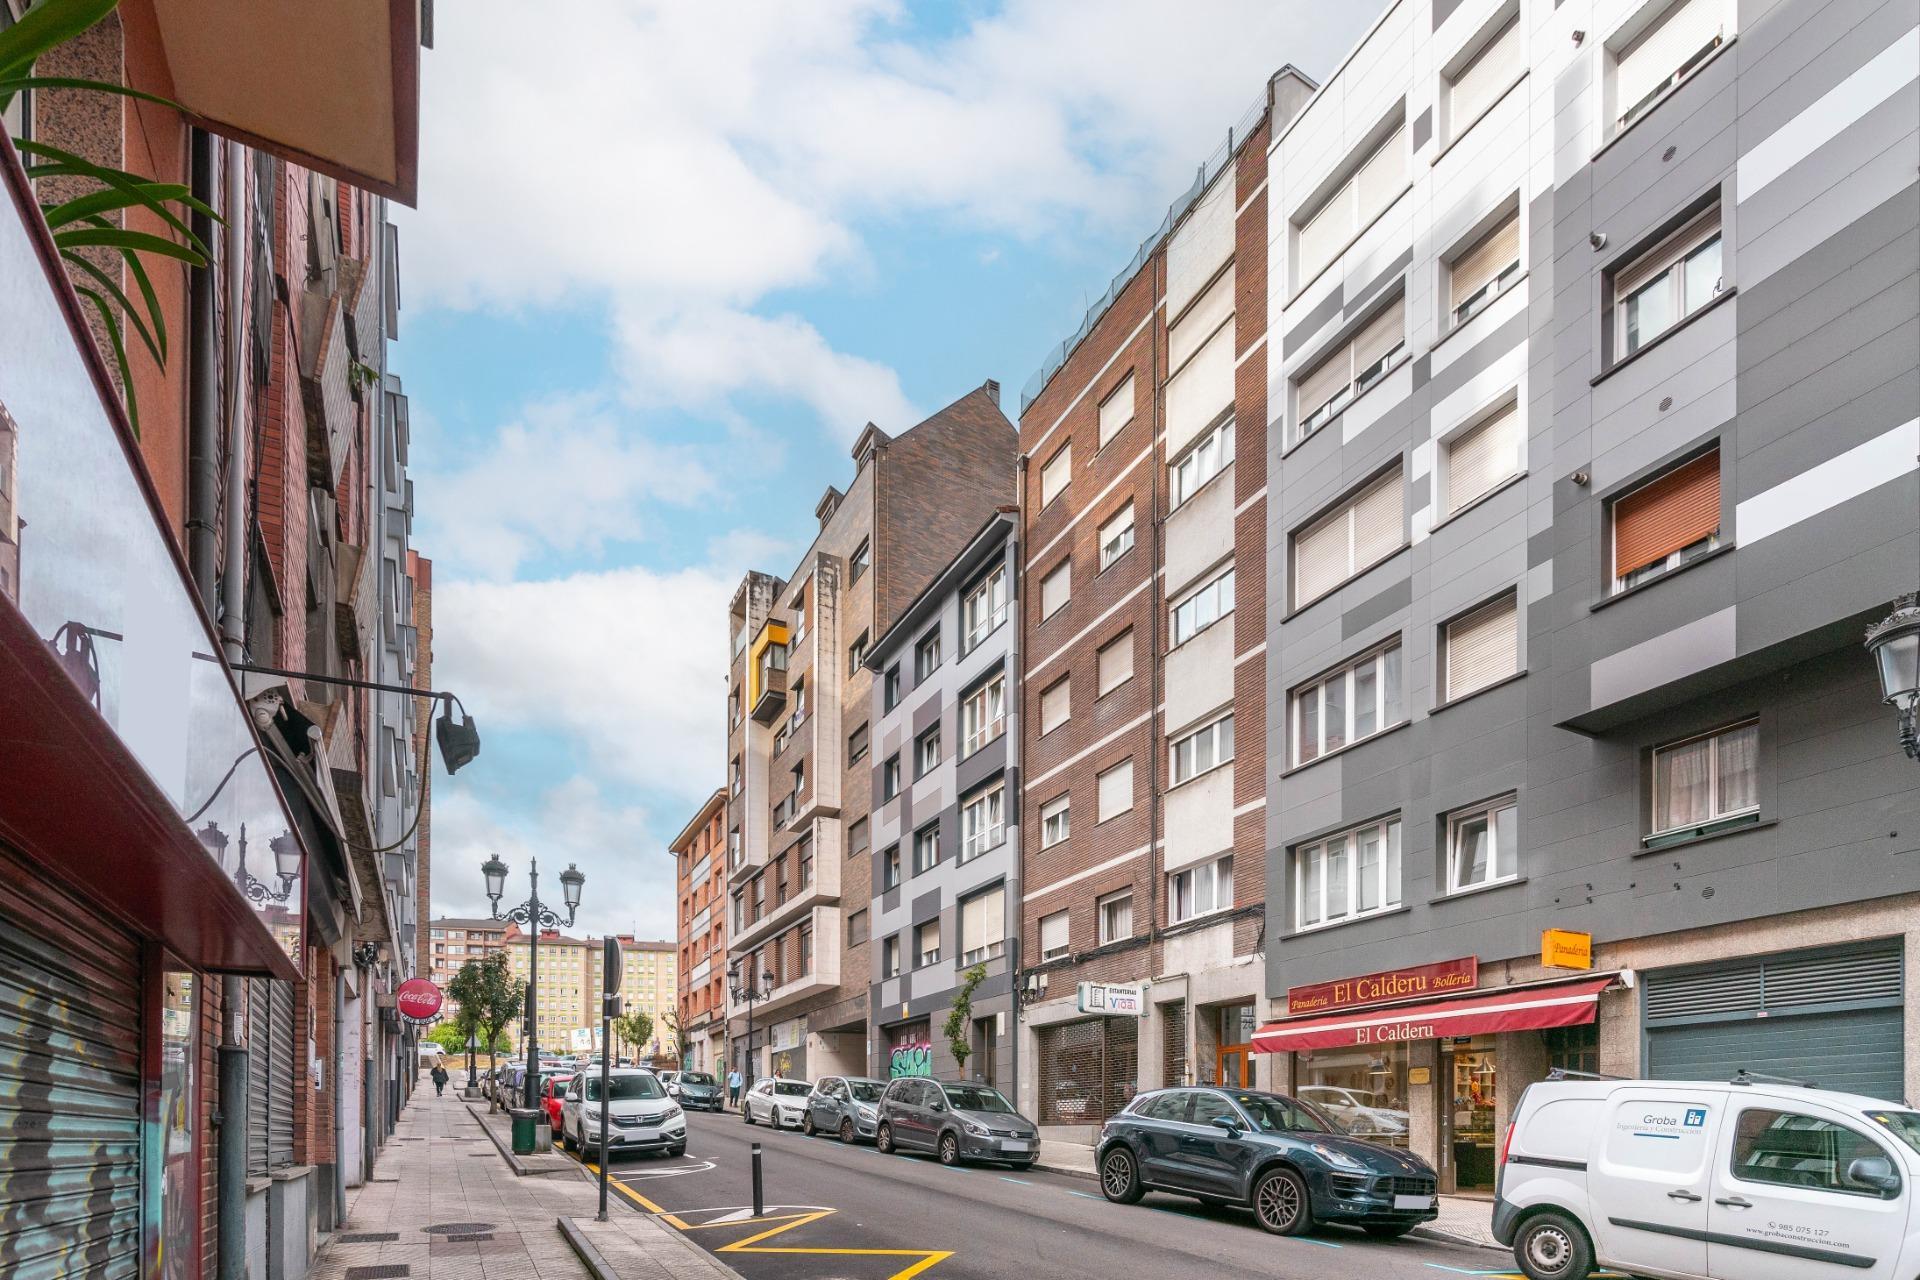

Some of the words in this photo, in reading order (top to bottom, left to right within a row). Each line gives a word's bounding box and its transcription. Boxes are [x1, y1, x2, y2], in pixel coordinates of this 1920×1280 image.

[1334, 983, 1352, 1003] El
[1356, 974, 1427, 1000] Calderu
[1355, 1027, 1371, 1043] El
[1376, 1022, 1434, 1041] Calderu
[1643, 1114, 1678, 1126] Groba
[1746, 1227, 1850, 1249] www.grobaconstruccion.com
[1778, 1223, 1794, 1232] 985
[1795, 1225, 1812, 1235] 075
[1814, 1229, 1830, 1237] 127
